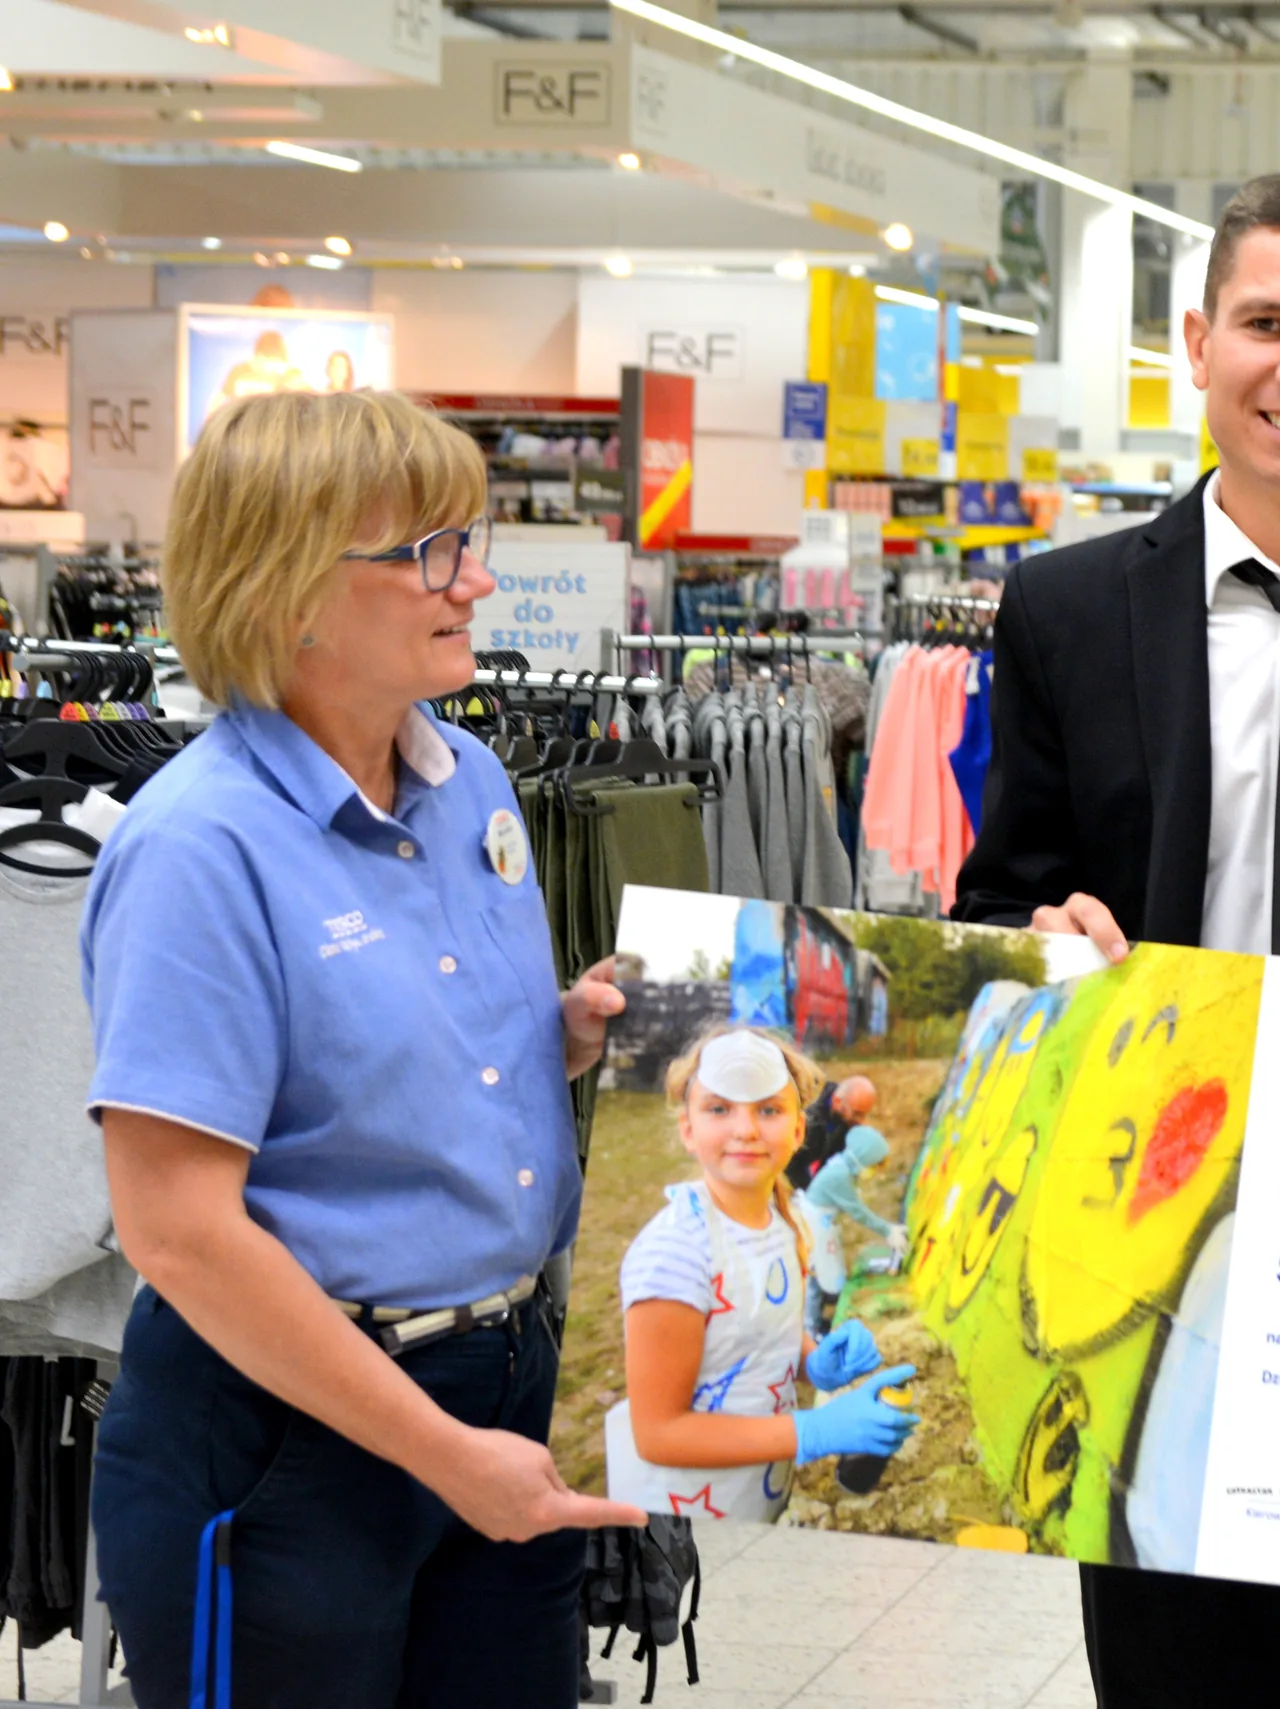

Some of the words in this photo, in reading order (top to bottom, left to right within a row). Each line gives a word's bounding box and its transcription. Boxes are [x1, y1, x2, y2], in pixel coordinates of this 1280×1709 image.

[503, 69, 602, 118] F&F
[646, 331, 737, 374] F&F
[89, 397, 151, 454] F&F
[514, 597, 554, 624] do
